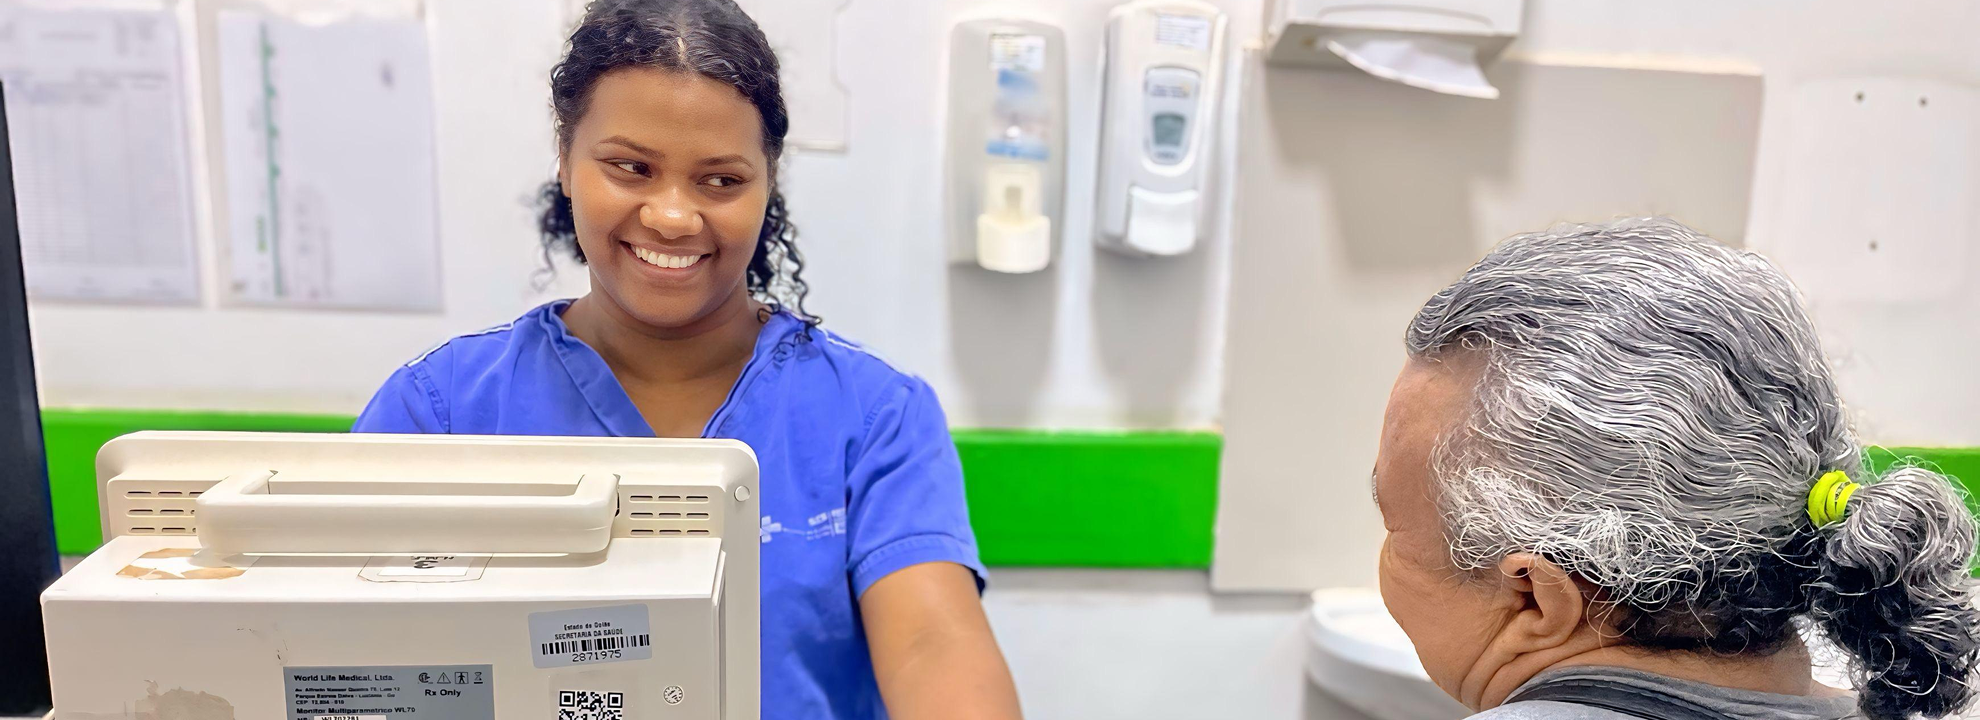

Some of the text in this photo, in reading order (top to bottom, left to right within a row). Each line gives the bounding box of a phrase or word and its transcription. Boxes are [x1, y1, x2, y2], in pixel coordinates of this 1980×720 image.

[564, 623, 583, 631] Estado
[554, 631, 592, 640] SECRETARIA
[603, 628, 624, 636] SAÚDE
[572, 649, 622, 662] 2871975
[293, 674, 319, 682] World
[439, 689, 462, 698] Only
